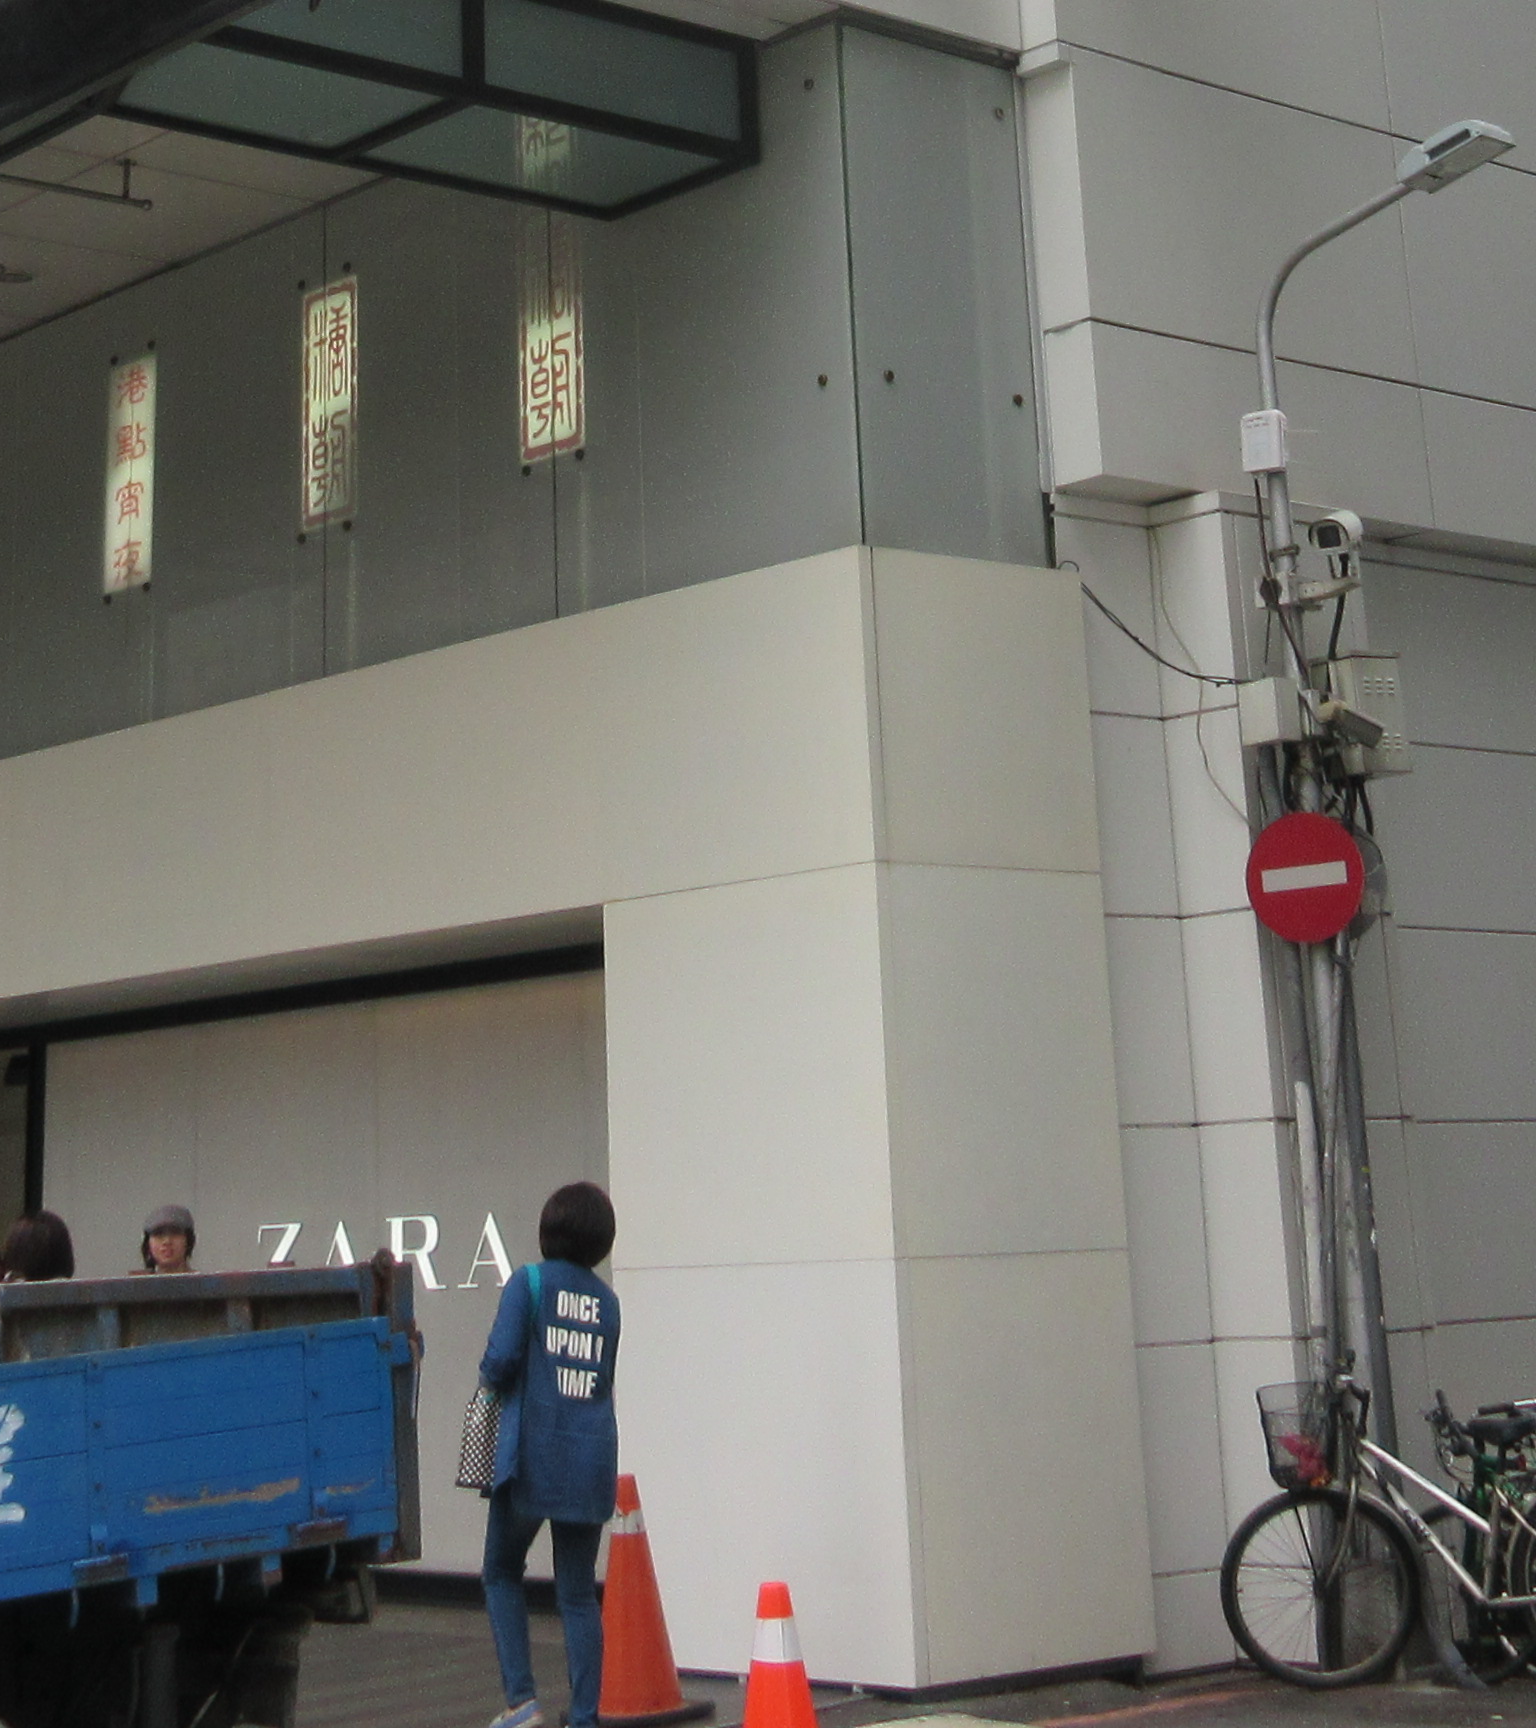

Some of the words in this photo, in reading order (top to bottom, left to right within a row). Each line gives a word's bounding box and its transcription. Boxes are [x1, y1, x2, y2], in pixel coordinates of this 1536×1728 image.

[112, 364, 150, 587] 港點宵夜
[257, 1211, 516, 1290] ZARA
[556, 1290, 601, 1325] ONCE
[545, 1325, 592, 1362] UPON
[555, 1366, 599, 1400] TIME
